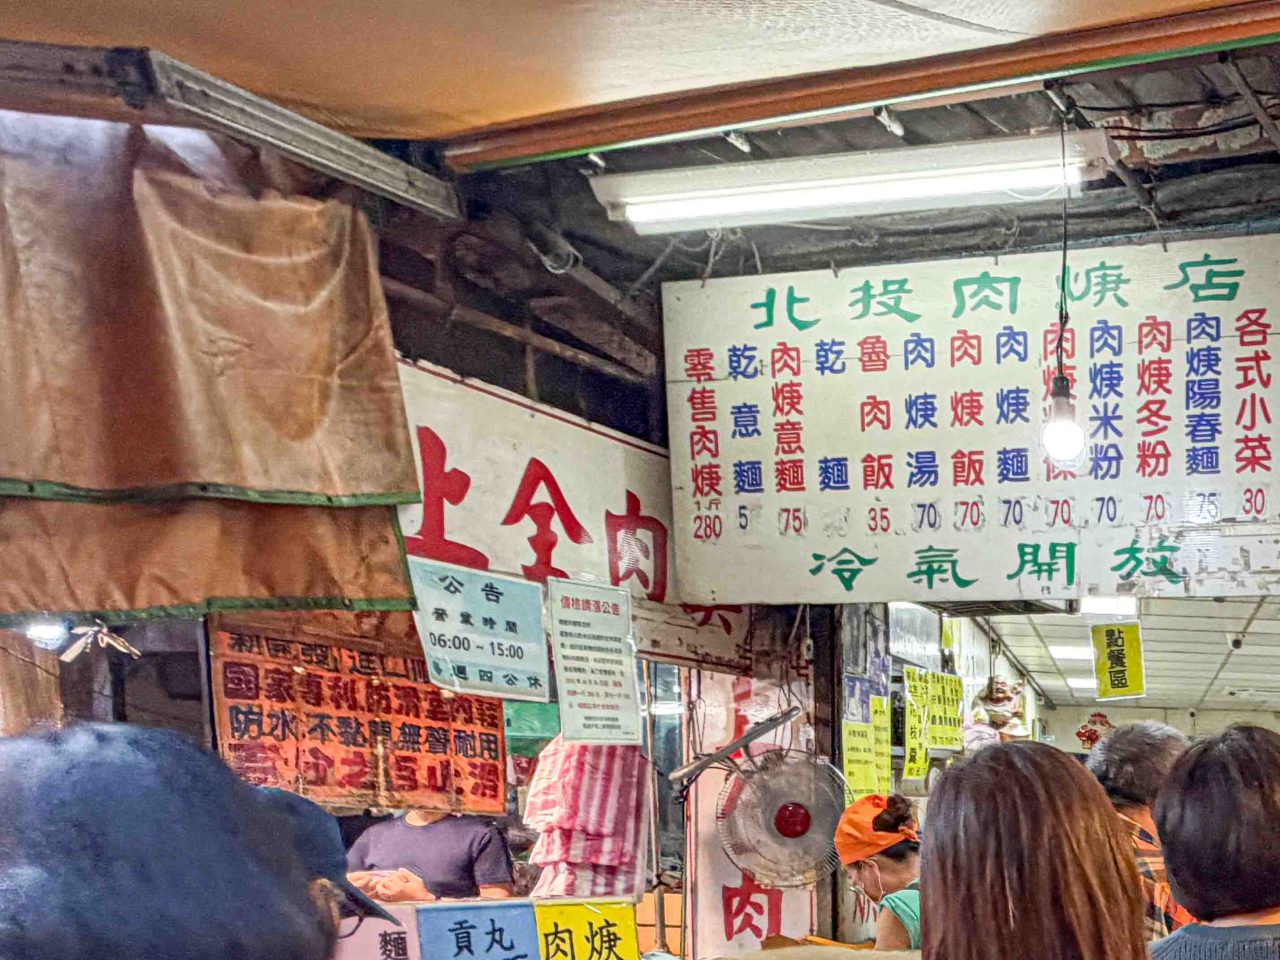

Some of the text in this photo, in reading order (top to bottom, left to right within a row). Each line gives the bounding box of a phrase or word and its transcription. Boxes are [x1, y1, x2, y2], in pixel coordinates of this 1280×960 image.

[1234, 308, 1272, 474] 各式小菜
[857, 335, 895, 491] 魯肉飯
[960, 501, 981, 527] 70
[1002, 499, 1023, 527] 70
[1050, 499, 1072, 527] 70
[1095, 496, 1117, 524] 70
[1143, 494, 1165, 521] 70
[1242, 488, 1265, 515] 30
[693, 514, 723, 540] 280
[781, 507, 802, 535] 75
[867, 507, 890, 533] 35
[916, 503, 937, 529] 70
[809, 539, 1185, 592] 冷氣開放
[438, 574, 504, 604] 公告
[429, 632, 471, 651] 06:00
[490, 641, 524, 660] 15:00
[447, 917, 516, 958] 貢丸
